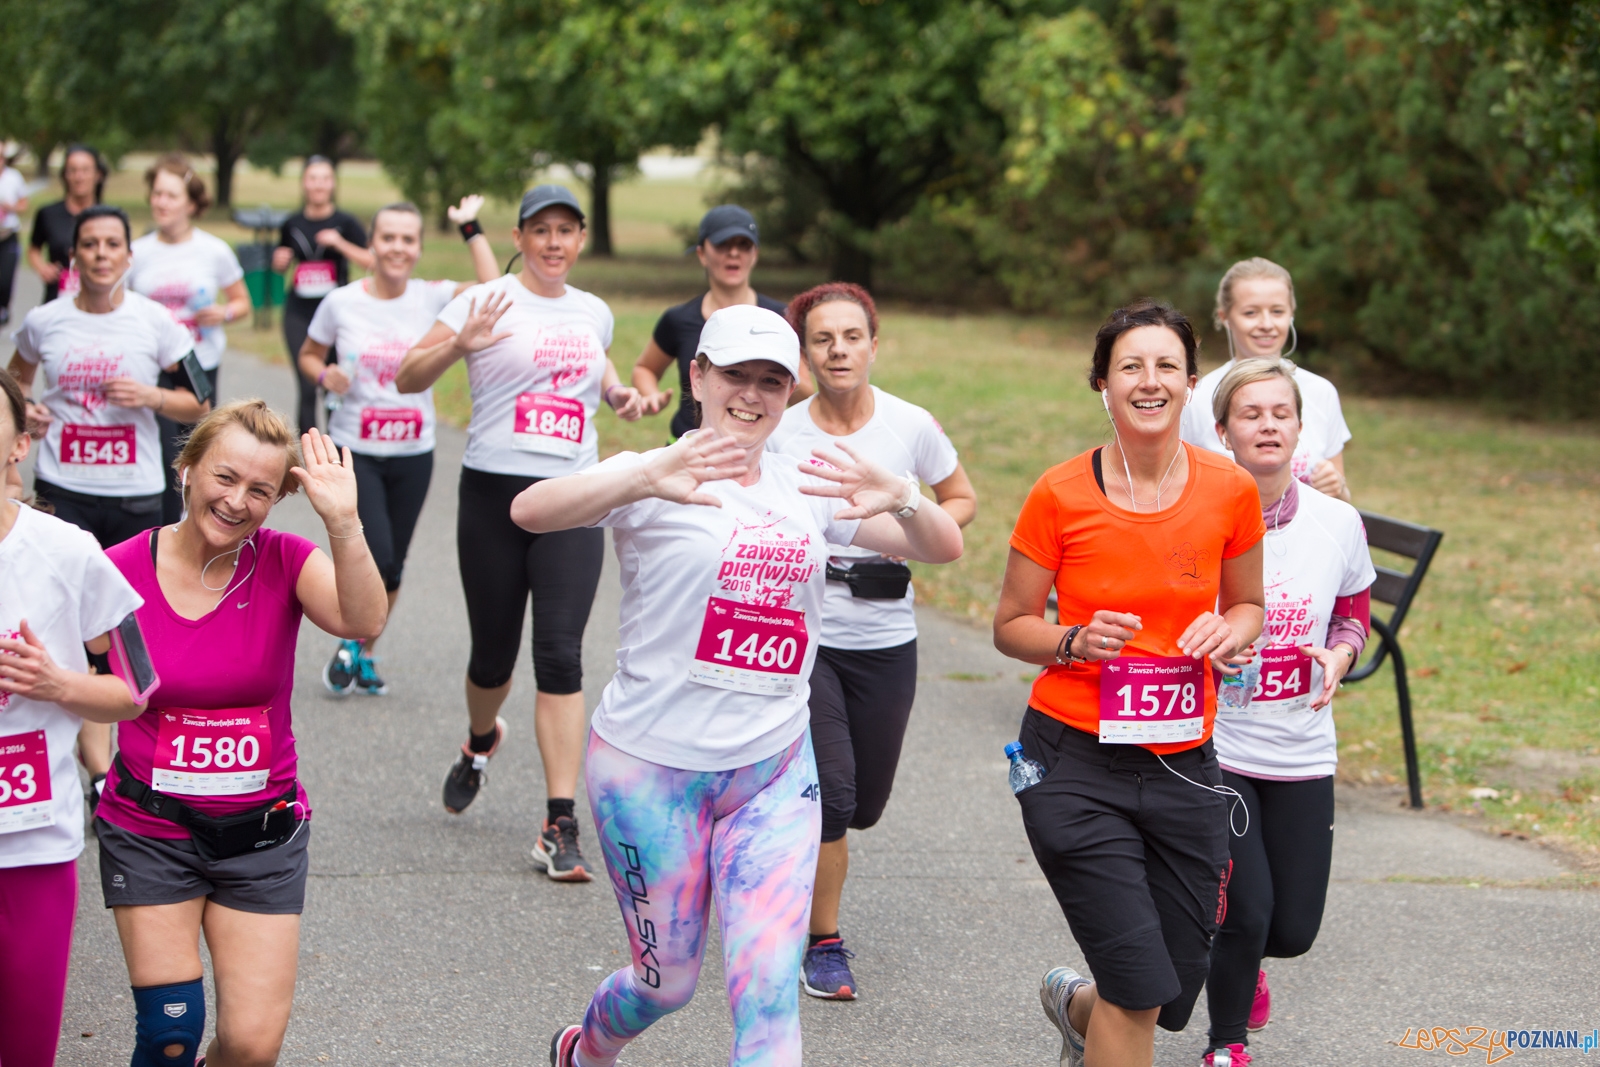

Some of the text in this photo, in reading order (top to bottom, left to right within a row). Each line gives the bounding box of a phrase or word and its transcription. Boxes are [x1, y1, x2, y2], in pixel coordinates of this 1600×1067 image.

[367, 419, 417, 440] 1491
[524, 409, 581, 440] 1848
[69, 439, 130, 464] 1543
[735, 543, 806, 564] zawsze
[775, 540, 798, 548] KOBIET
[721, 579, 751, 592] 2016
[1277, 601, 1300, 609] KOBIET
[713, 628, 797, 669] 1460
[1128, 666, 1154, 675] Zawsze
[1180, 664, 1193, 673] 2016
[1116, 682, 1196, 717] 1578
[183, 717, 206, 727] Zawsze
[235, 717, 251, 726] 2016
[169, 735, 260, 769] 1580
[1215, 881, 1226, 924] CRAFT
[618, 841, 661, 989] POLSKA
